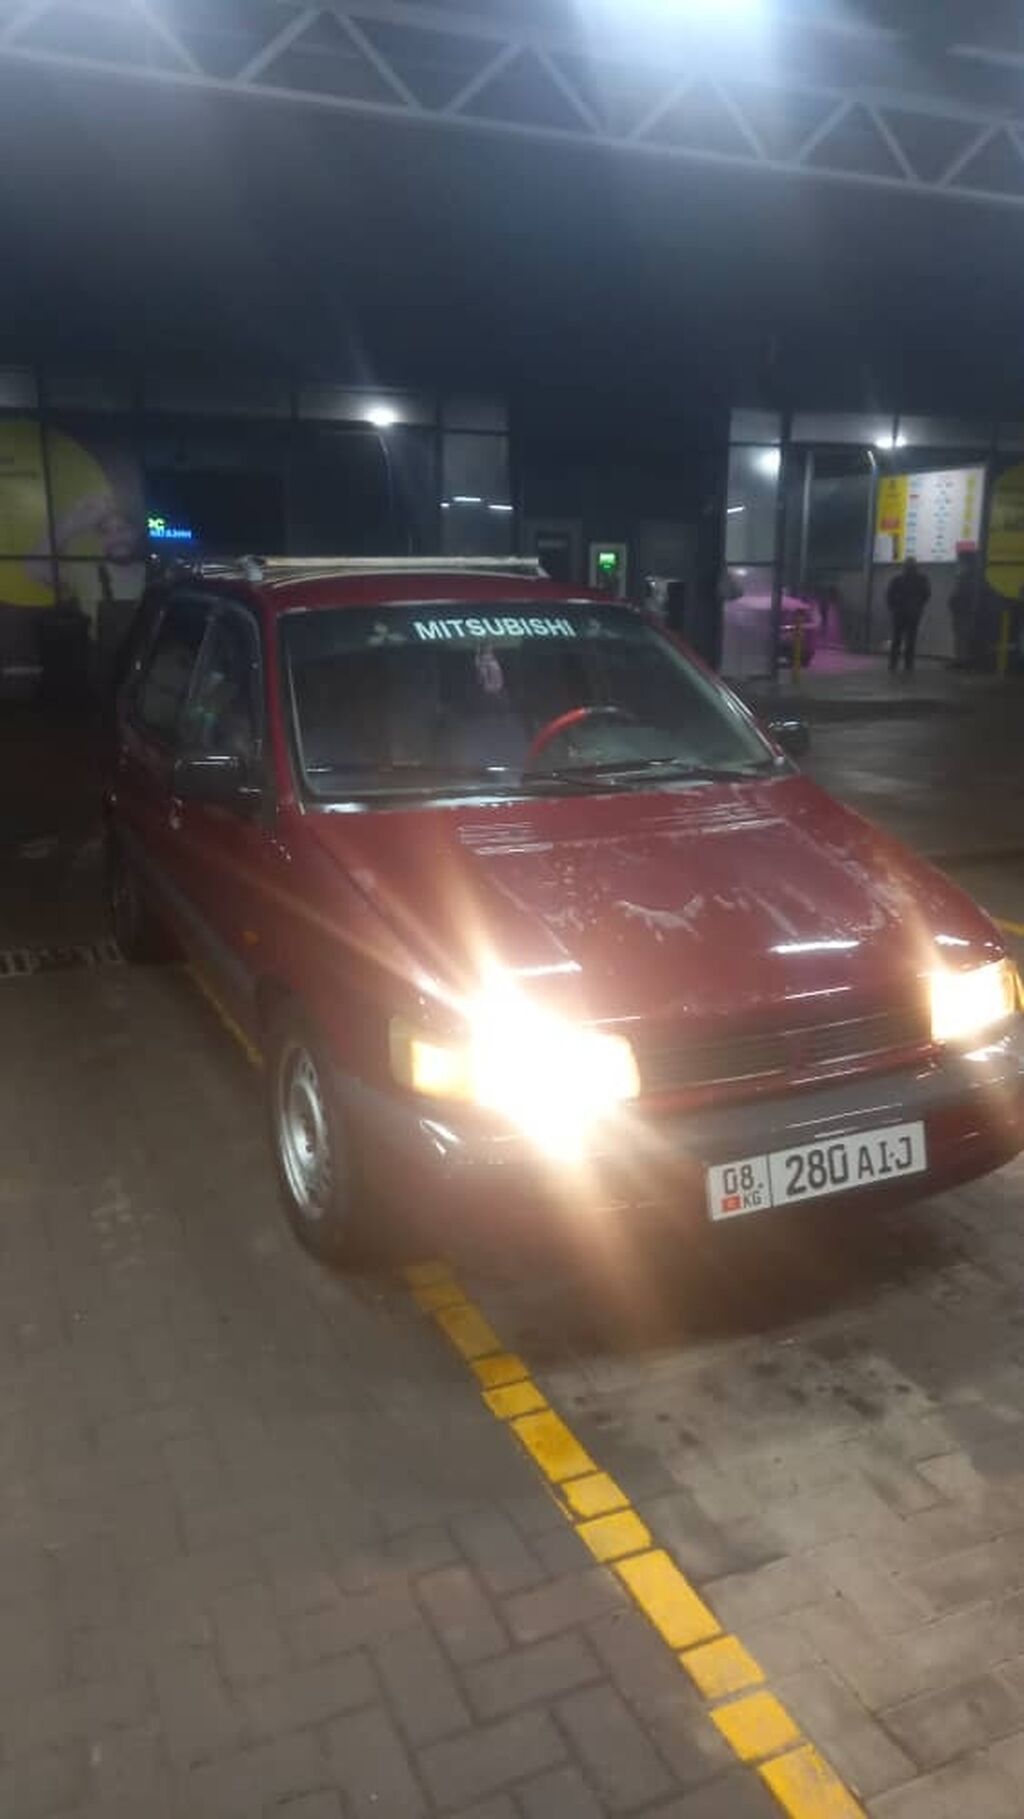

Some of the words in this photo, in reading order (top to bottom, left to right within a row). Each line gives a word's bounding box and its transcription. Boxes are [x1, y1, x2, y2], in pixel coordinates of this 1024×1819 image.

[413, 617, 576, 640] MITSUBISHI
[722, 1164, 755, 1194] 08
[785, 1144, 849, 1197] 280
[743, 1191, 763, 1209] KG
